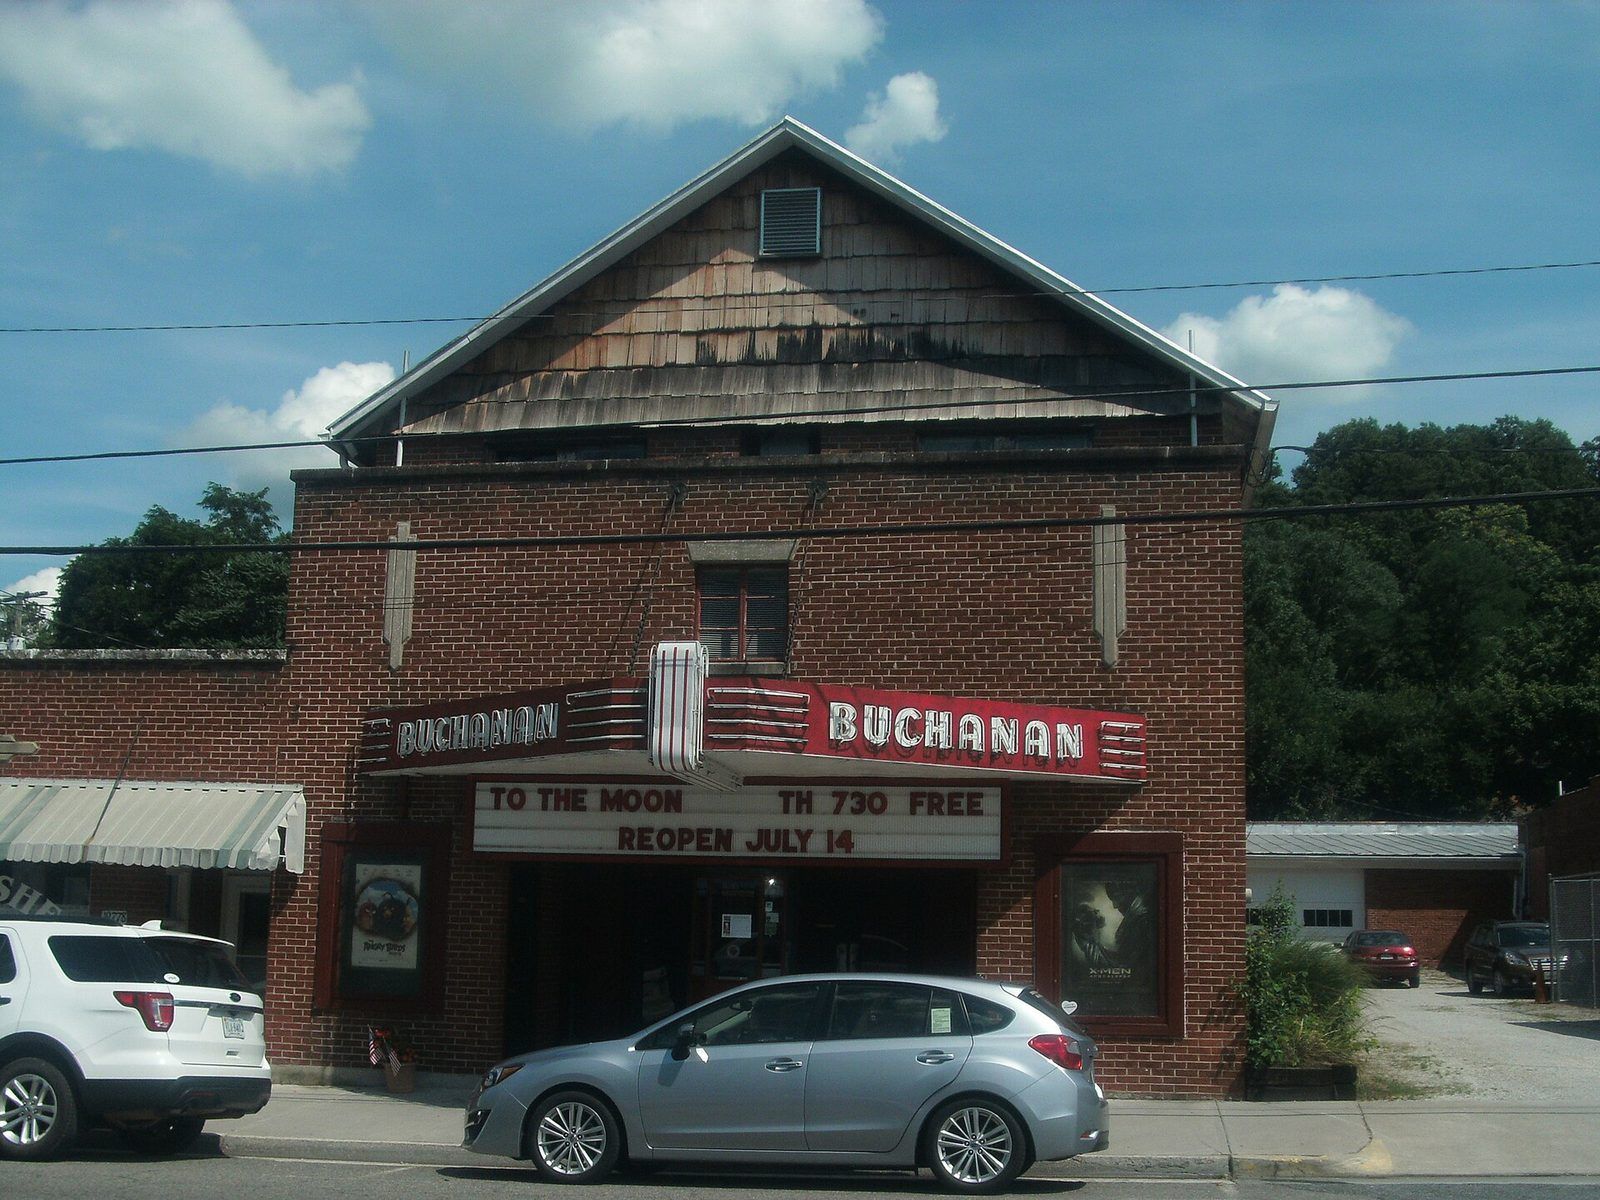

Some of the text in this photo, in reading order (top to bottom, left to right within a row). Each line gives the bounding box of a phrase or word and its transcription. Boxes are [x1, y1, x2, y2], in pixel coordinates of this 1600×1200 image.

[396, 702, 559, 757] BUCHANAN
[828, 701, 1084, 760] BUCHANAN
[489, 787, 984, 816] TO THE MOON TH 730 FREE
[618, 826, 854, 854] REOPEN JULY 14
